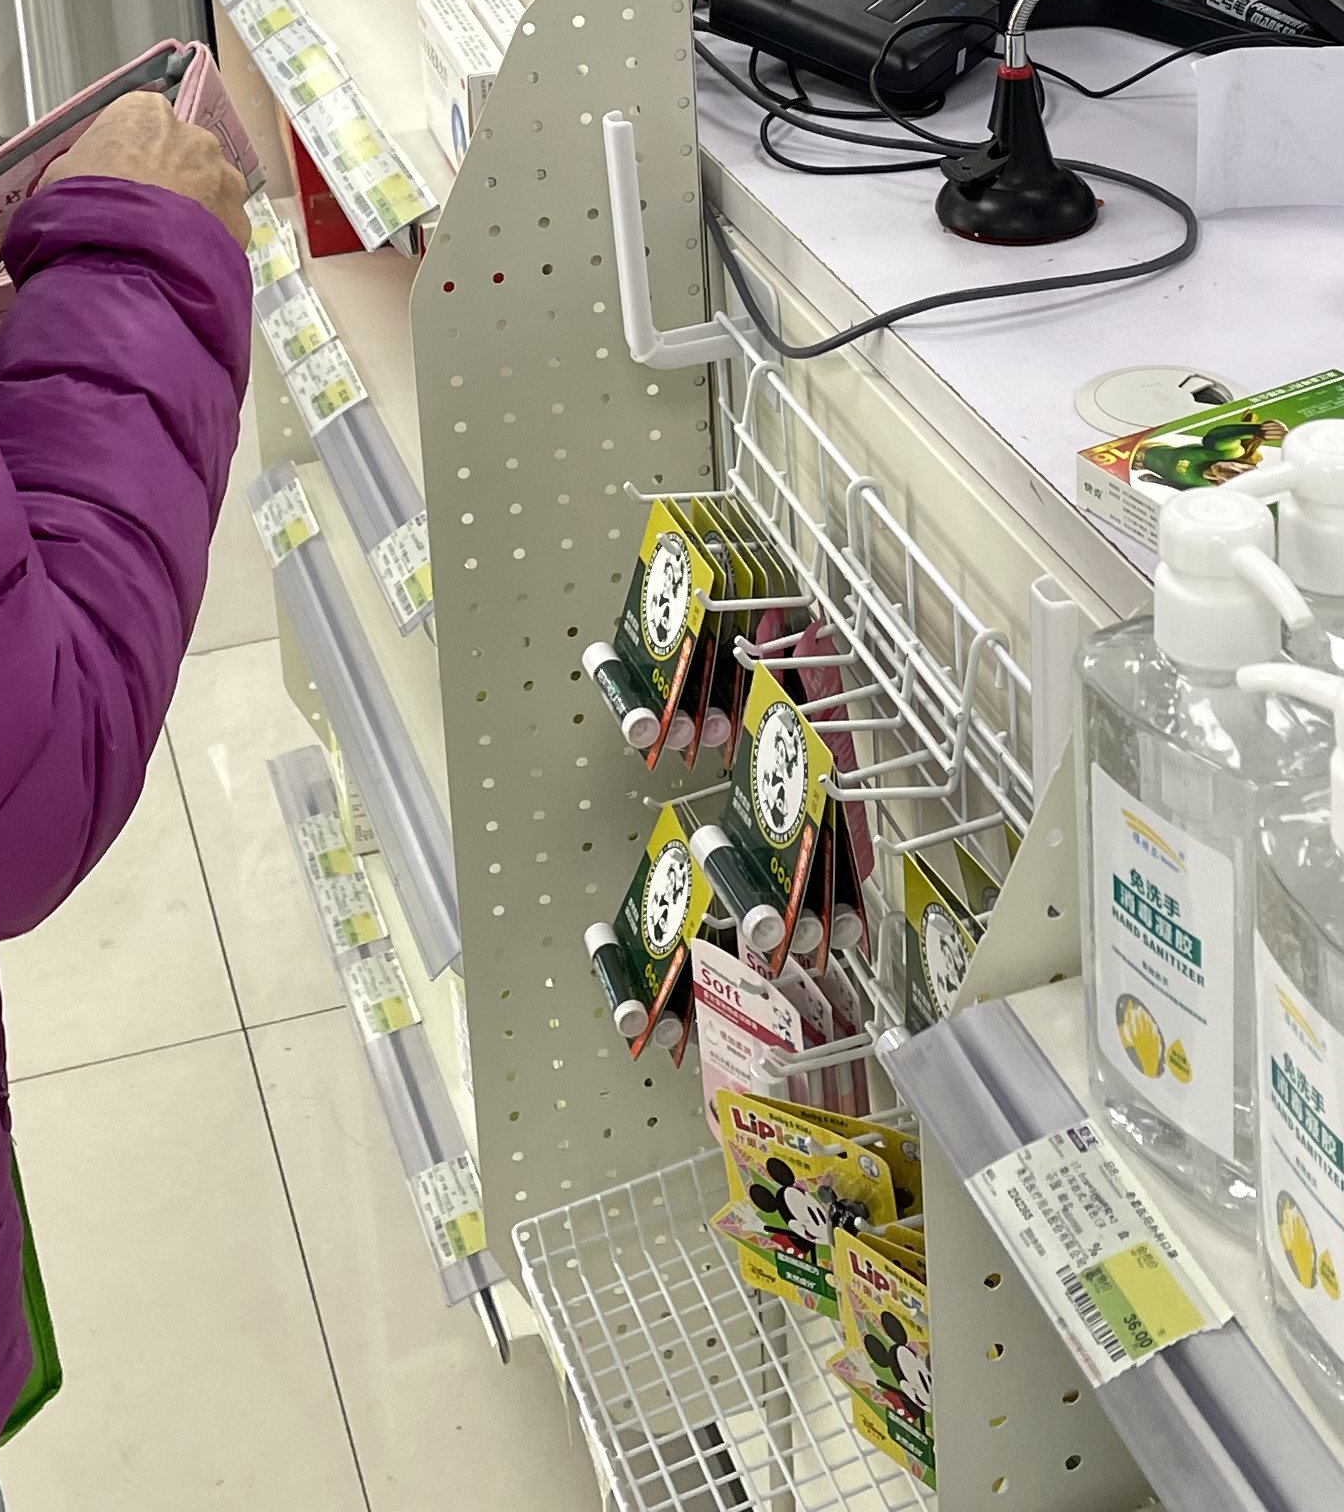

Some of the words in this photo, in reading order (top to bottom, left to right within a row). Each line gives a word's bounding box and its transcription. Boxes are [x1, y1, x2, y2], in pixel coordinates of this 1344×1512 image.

[1129, 867, 1181, 918] 免洗手
[1112, 905, 1141, 945] HAND
[1143, 928, 1206, 988] SANITIZER
[701, 967, 743, 1008] Soft
[1270, 1088, 1294, 1135] HAND
[1087, 1242, 1104, 1259] %
[1120, 1312, 1154, 1351] 36.00
